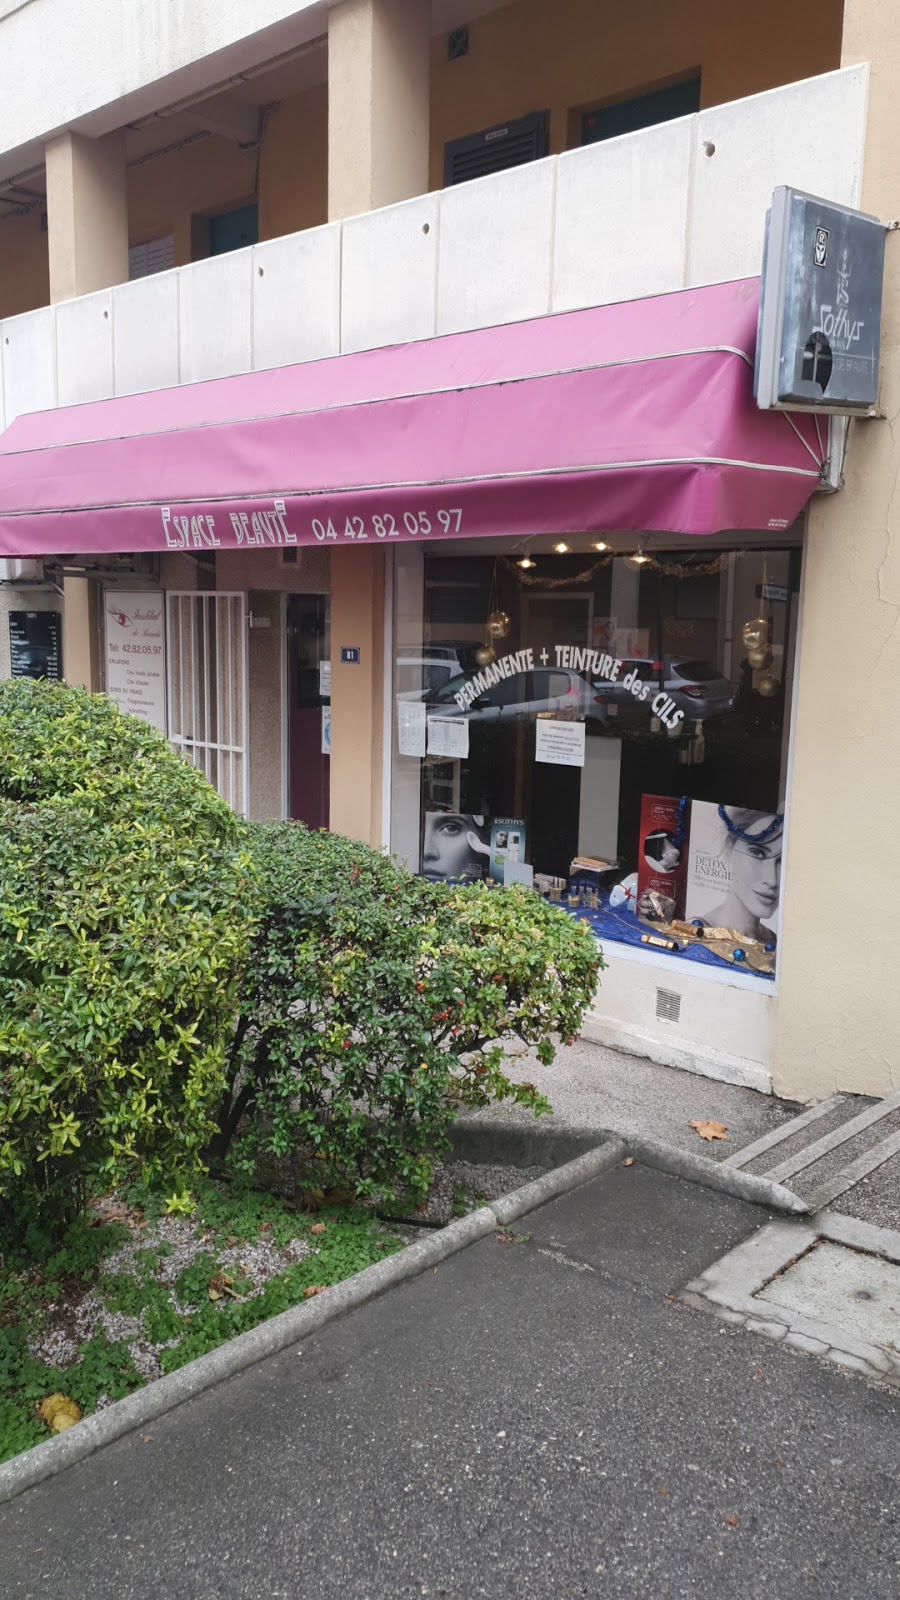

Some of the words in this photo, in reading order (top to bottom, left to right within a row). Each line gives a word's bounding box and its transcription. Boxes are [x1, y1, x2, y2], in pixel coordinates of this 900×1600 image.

[812, 304, 865, 350] Sothys
[161, 507, 220, 547] ESPACE
[311, 517, 338, 541] 04
[344, 516, 368, 539] 42
[372, 514, 400, 537] 82
[403, 511, 432, 535] 05
[437, 508, 463, 533] 97
[122, 644, 162, 655] 42.82.05.97
[346, 650, 354, 660] 81
[453, 648, 535, 711] PERMANENTE
[540, 648, 549, 666] +
[555, 645, 623, 682] TEINTURE
[622, 669, 650, 700] des
[651, 692, 685, 730] CILS
[695, 855, 727, 871] DETOX
